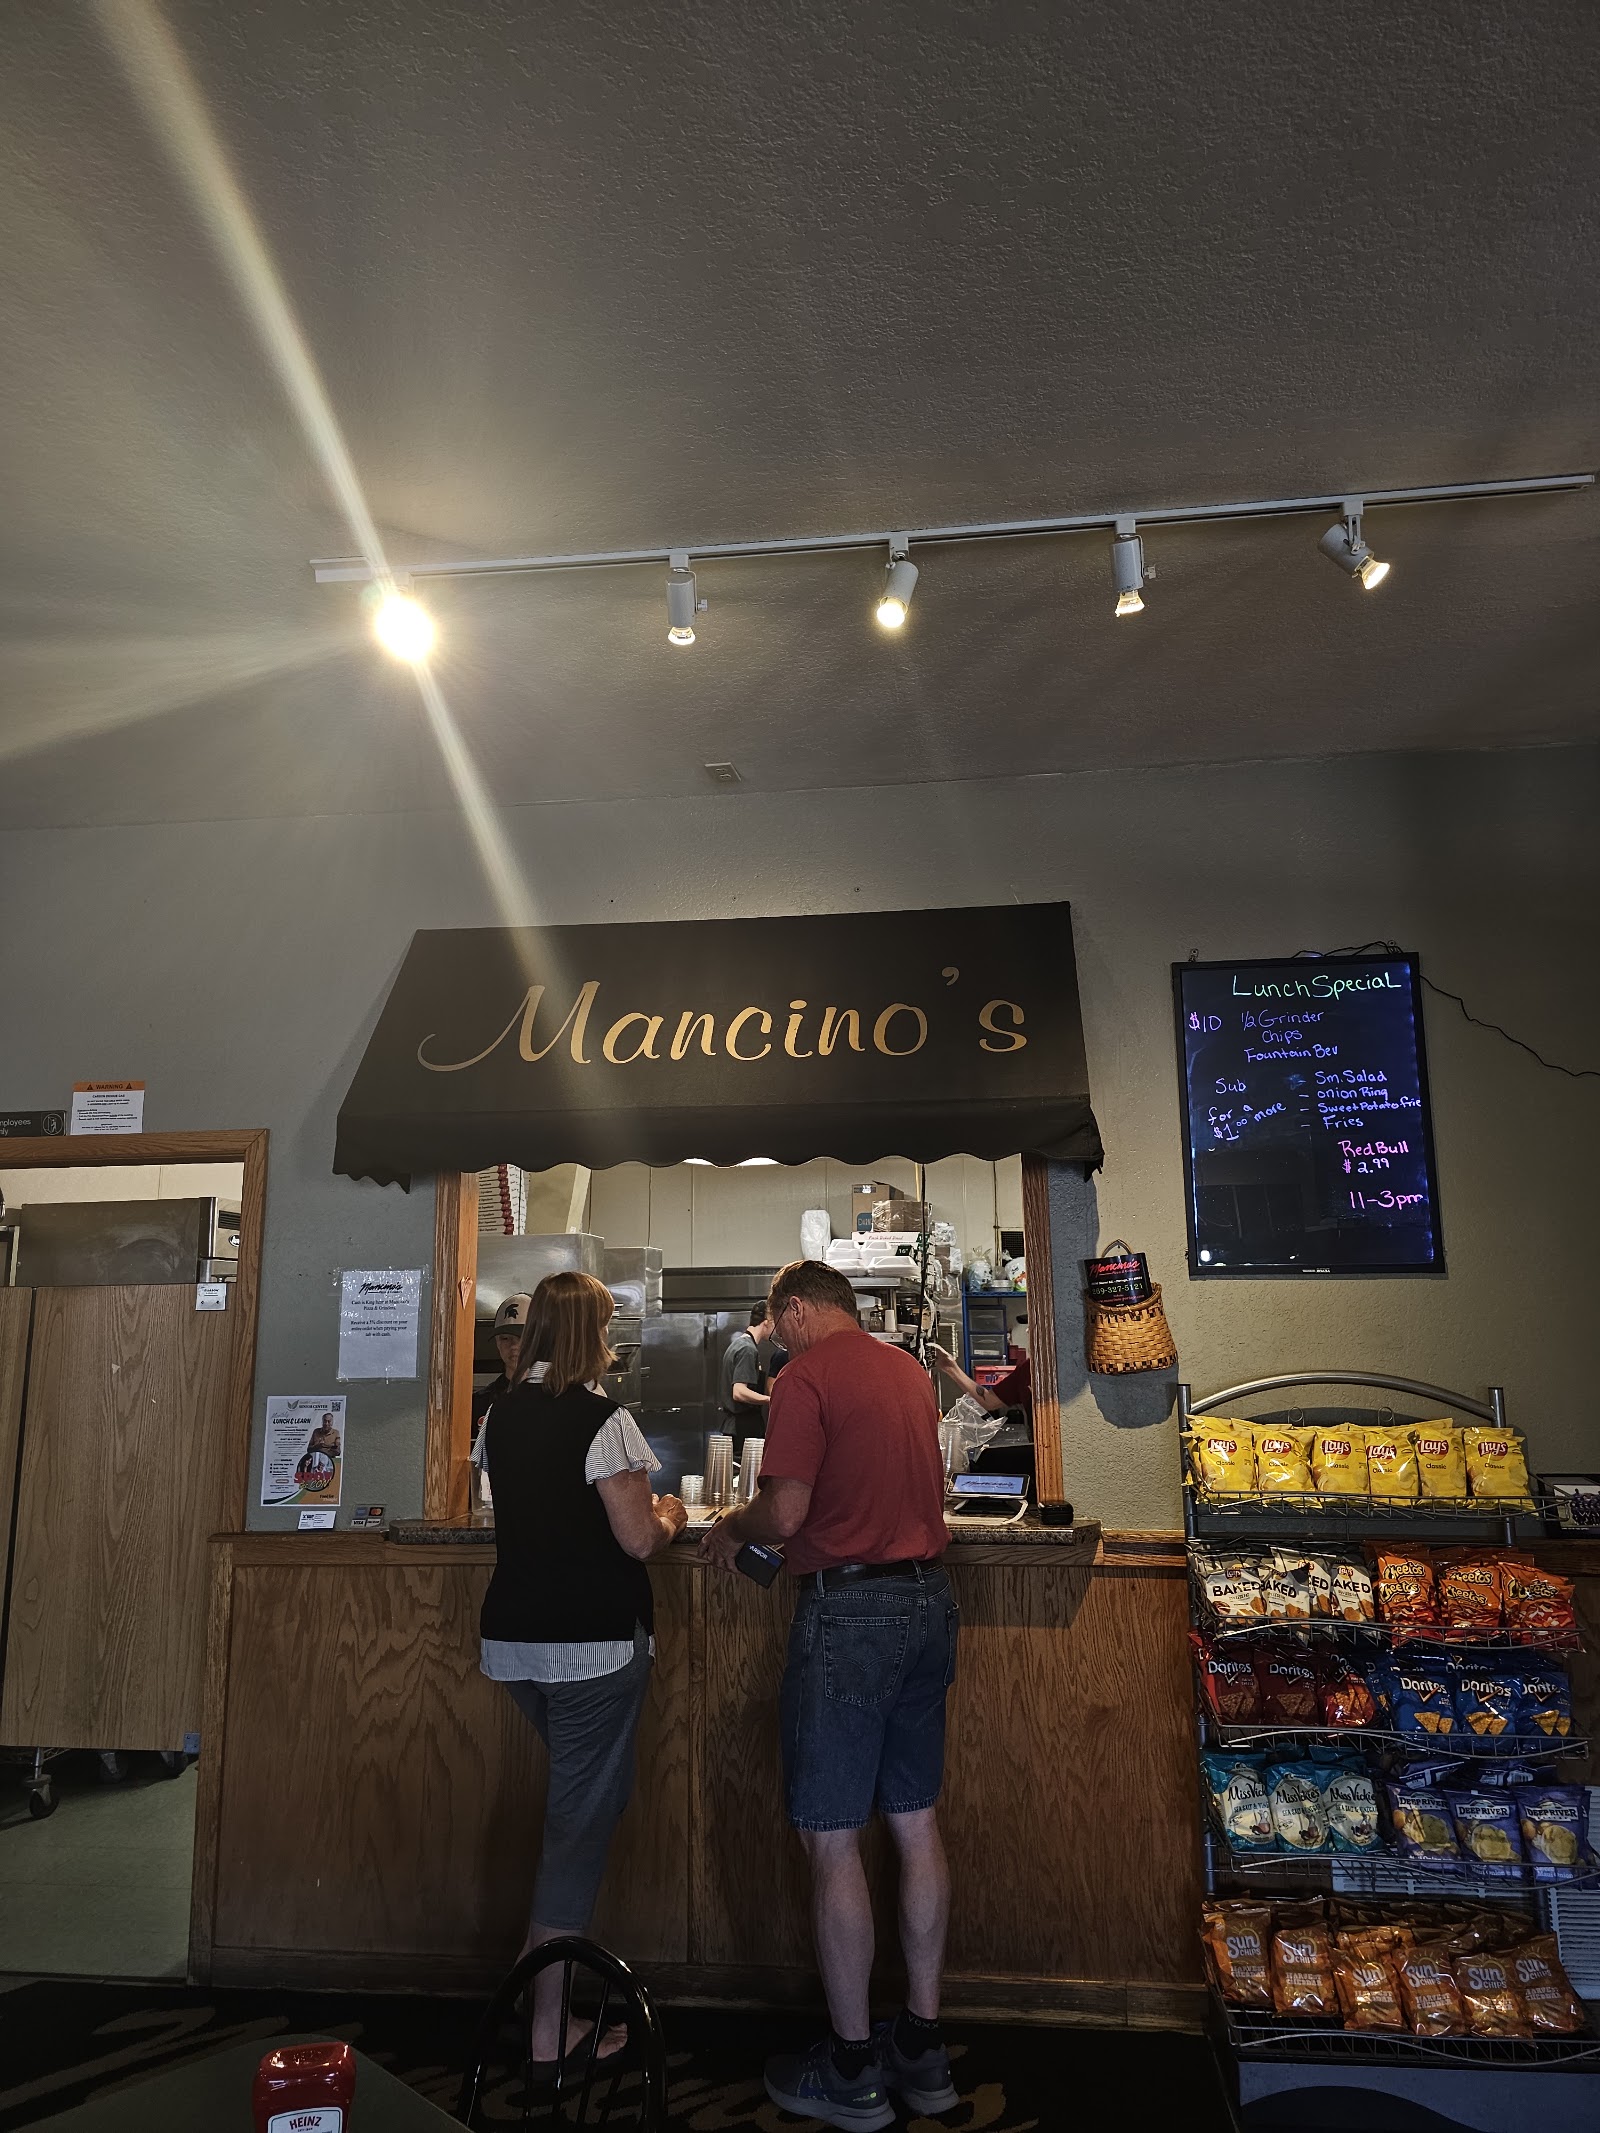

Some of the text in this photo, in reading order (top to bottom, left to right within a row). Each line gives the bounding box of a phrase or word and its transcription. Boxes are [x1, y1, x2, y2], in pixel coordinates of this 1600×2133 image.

[1233, 974, 1311, 997] Lunch
[417, 965, 1028, 1072] Mancino's
[1188, 1011, 1222, 1032] $10
[1258, 1009, 1324, 1028] Grinder
[1244, 1043, 1339, 1063] Fountain Bev
[1342, 1069, 1388, 1084] Salad
[1215, 1077, 1248, 1094] Sub
[1254, 1102, 1288, 1122] more
[1317, 1102, 1359, 1113] Sweet
[1359, 1100, 1399, 1111] Potato
[1208, 1106, 1233, 1126] for
[1322, 1114, 1364, 1130] Fries
[1337, 1140, 1410, 1157] Red Bull
[1213, 1580, 1260, 1596] BAKED
[1207, 1660, 1252, 1674] Doritos
[1400, 1677, 1446, 1694] Doritos
[1459, 1806, 1510, 1816] DEEP RIVER
[1527, 1808, 1577, 1818] DEEP RIVER
[1483, 1981, 1507, 1990] CHIPS
[289, 2115, 322, 2131] HEINZ
